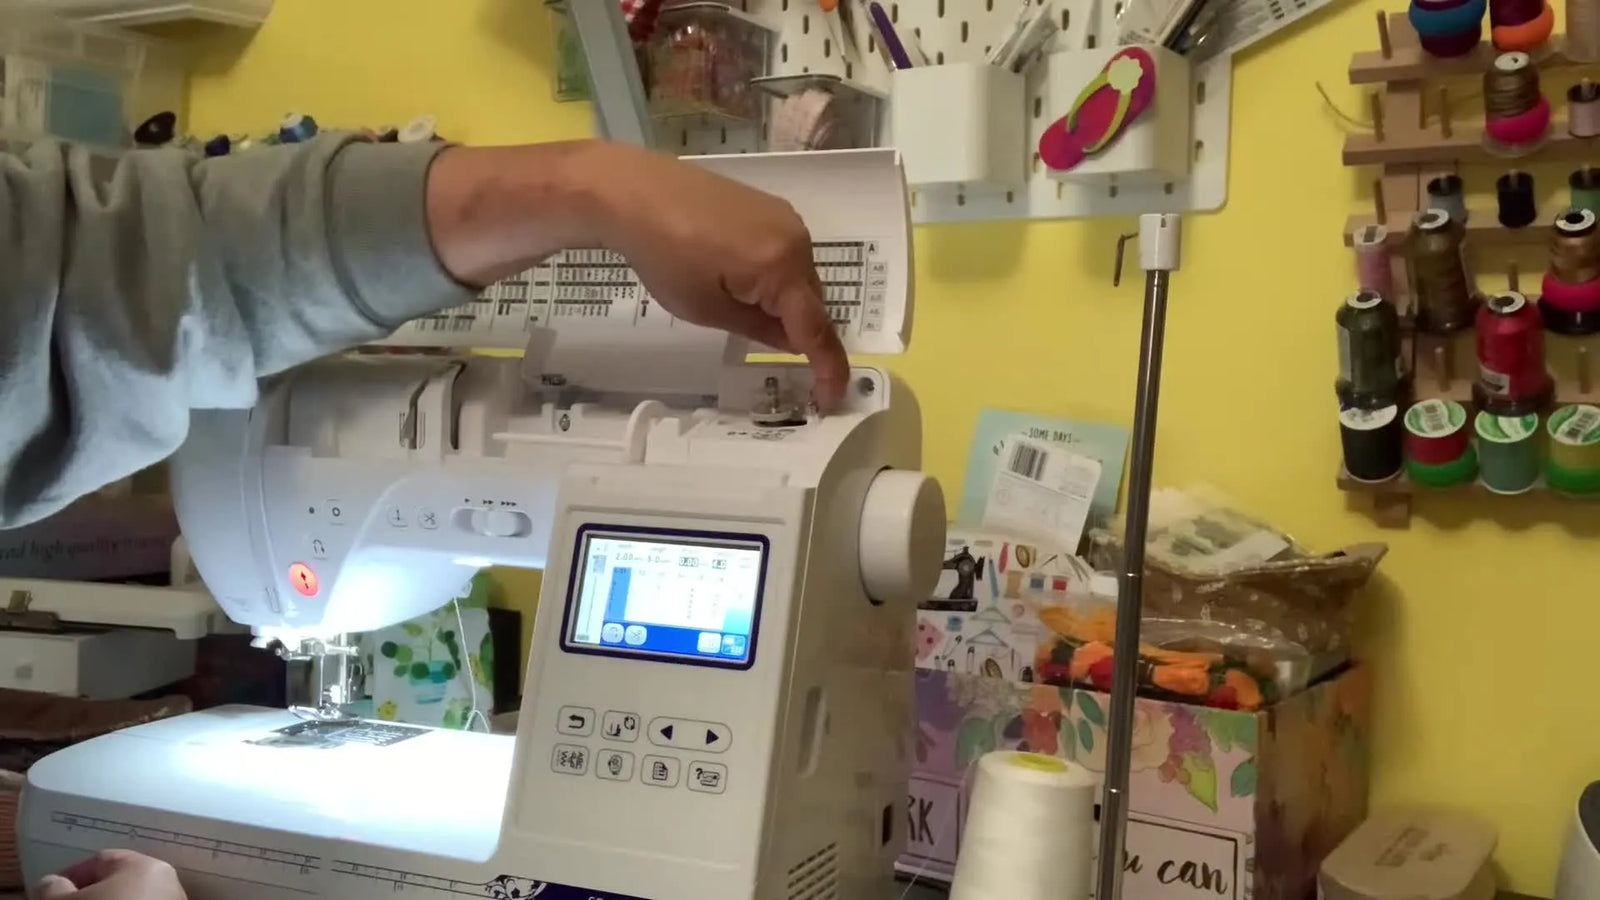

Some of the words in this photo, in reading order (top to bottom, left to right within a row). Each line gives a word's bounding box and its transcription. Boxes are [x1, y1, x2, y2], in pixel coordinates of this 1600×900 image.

[1028, 427, 1049, 440] SOME
[1053, 430, 1072, 443] DAYS
[1157, 859, 1228, 895] can
